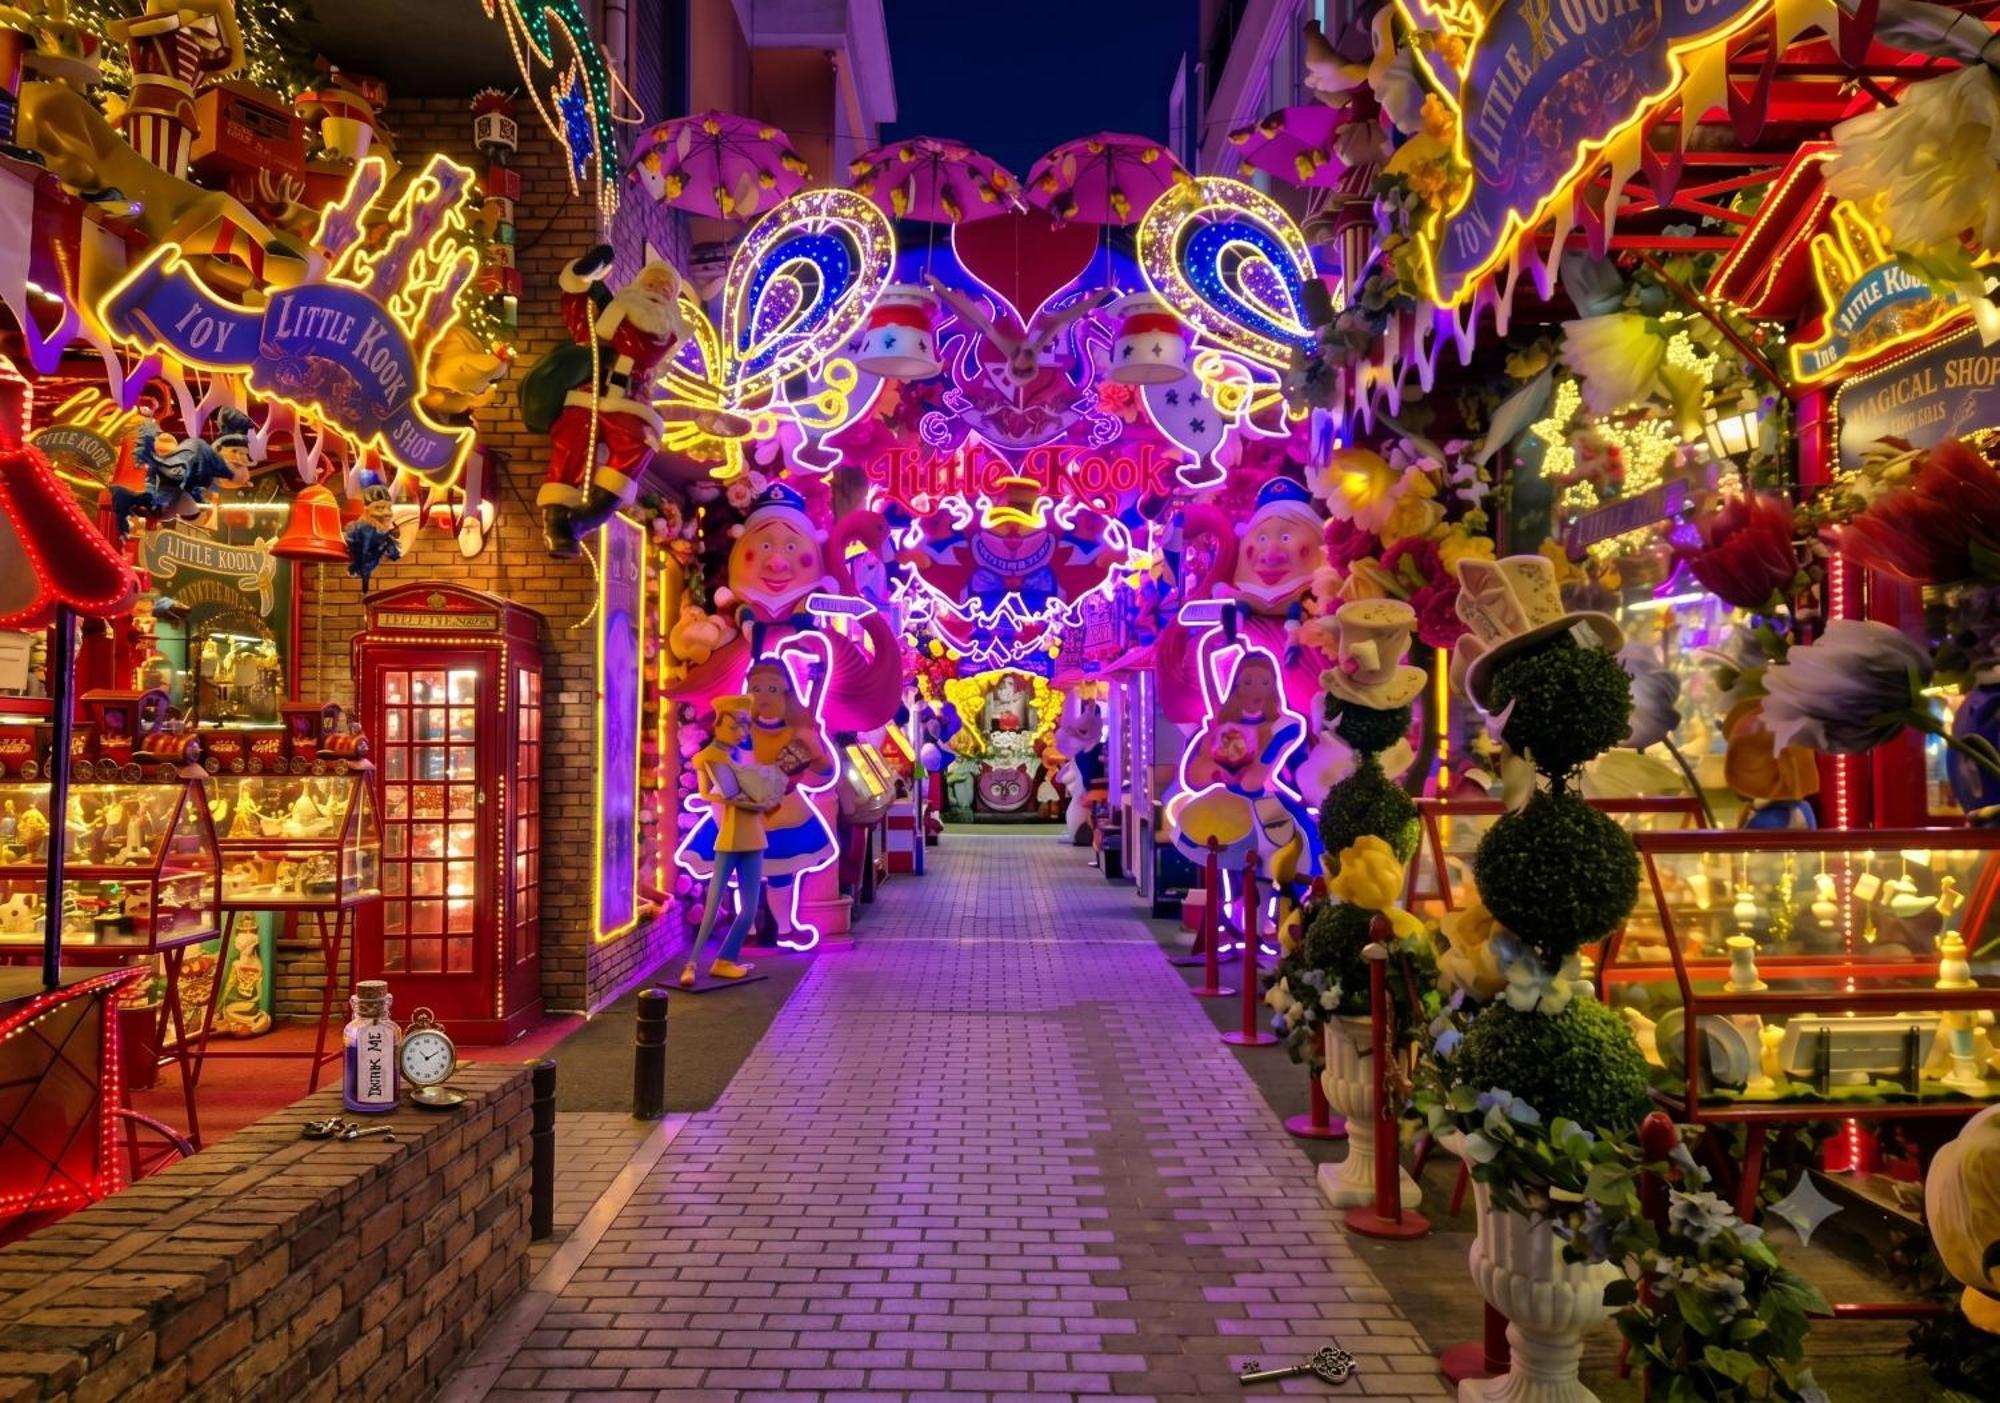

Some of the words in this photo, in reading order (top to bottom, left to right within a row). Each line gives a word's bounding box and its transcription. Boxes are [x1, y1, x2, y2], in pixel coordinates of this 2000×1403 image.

[1470, 43, 1533, 170] LITTLE
[275, 295, 355, 345] LITTLE
[352, 316, 408, 406] KOOK
[866, 445, 1007, 517] Little
[1026, 444, 1173, 519] Kook
[167, 536, 214, 566] LITTLE
[367, 1032, 382, 1052] ME
